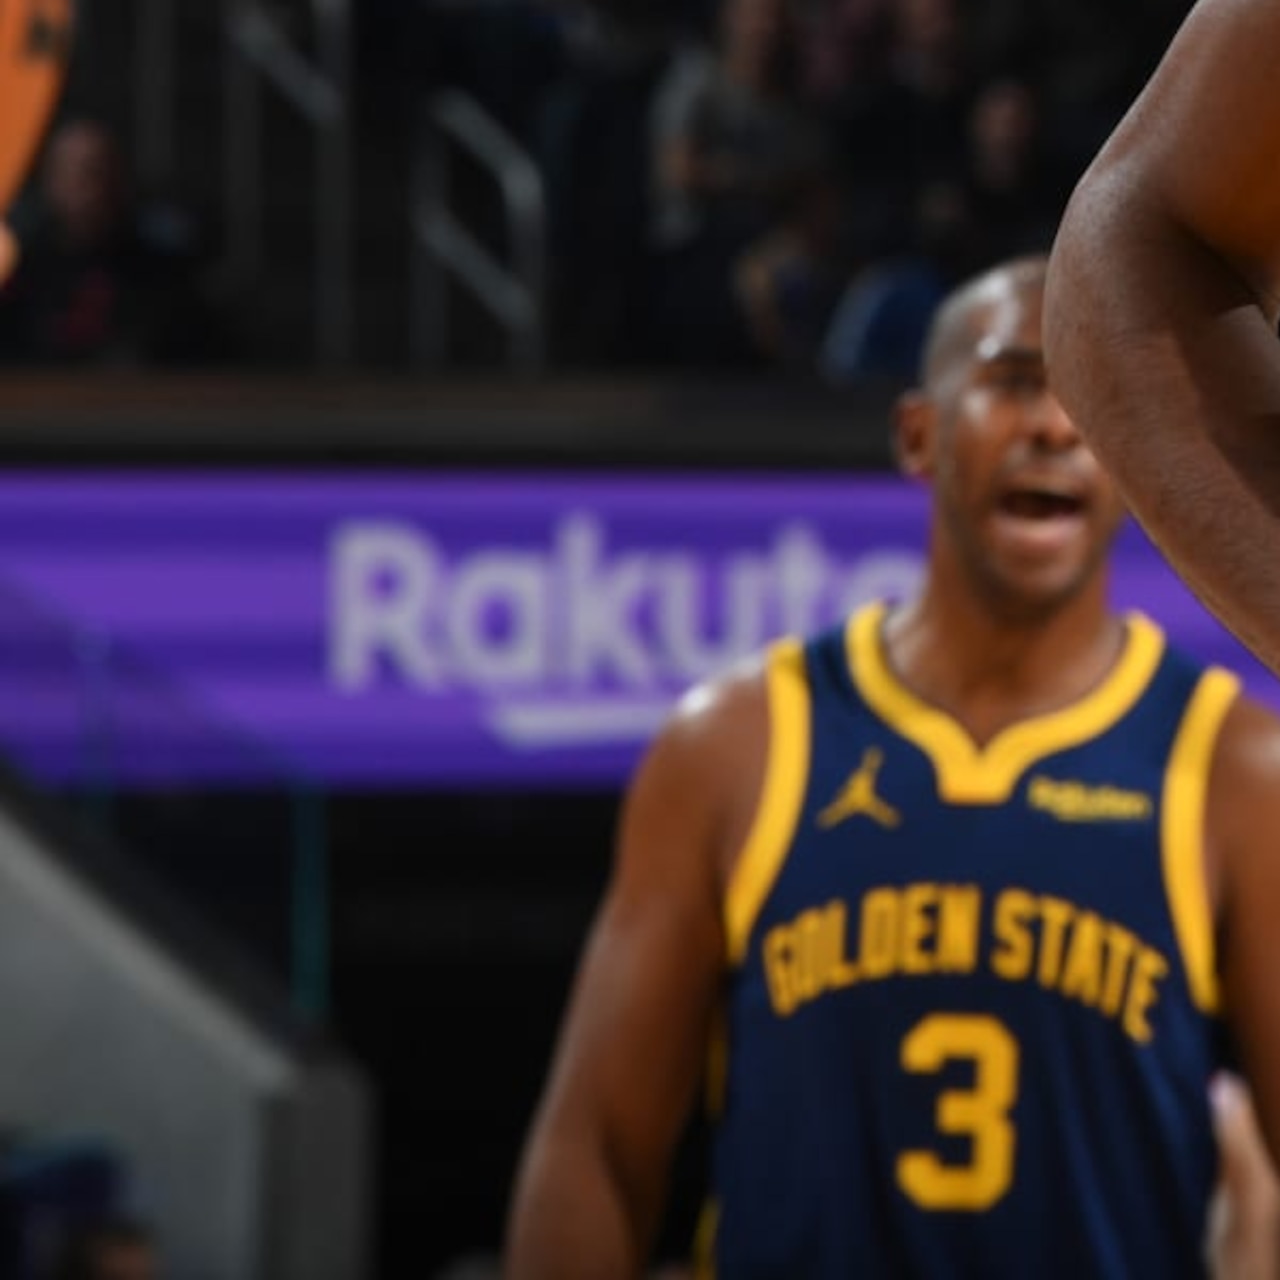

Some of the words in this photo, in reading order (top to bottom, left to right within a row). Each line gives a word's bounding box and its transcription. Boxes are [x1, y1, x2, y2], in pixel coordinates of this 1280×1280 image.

[762, 883, 981, 1015] GOLDEN
[991, 887, 1168, 1043] STATE
[897, 1013, 1019, 1211] 3
